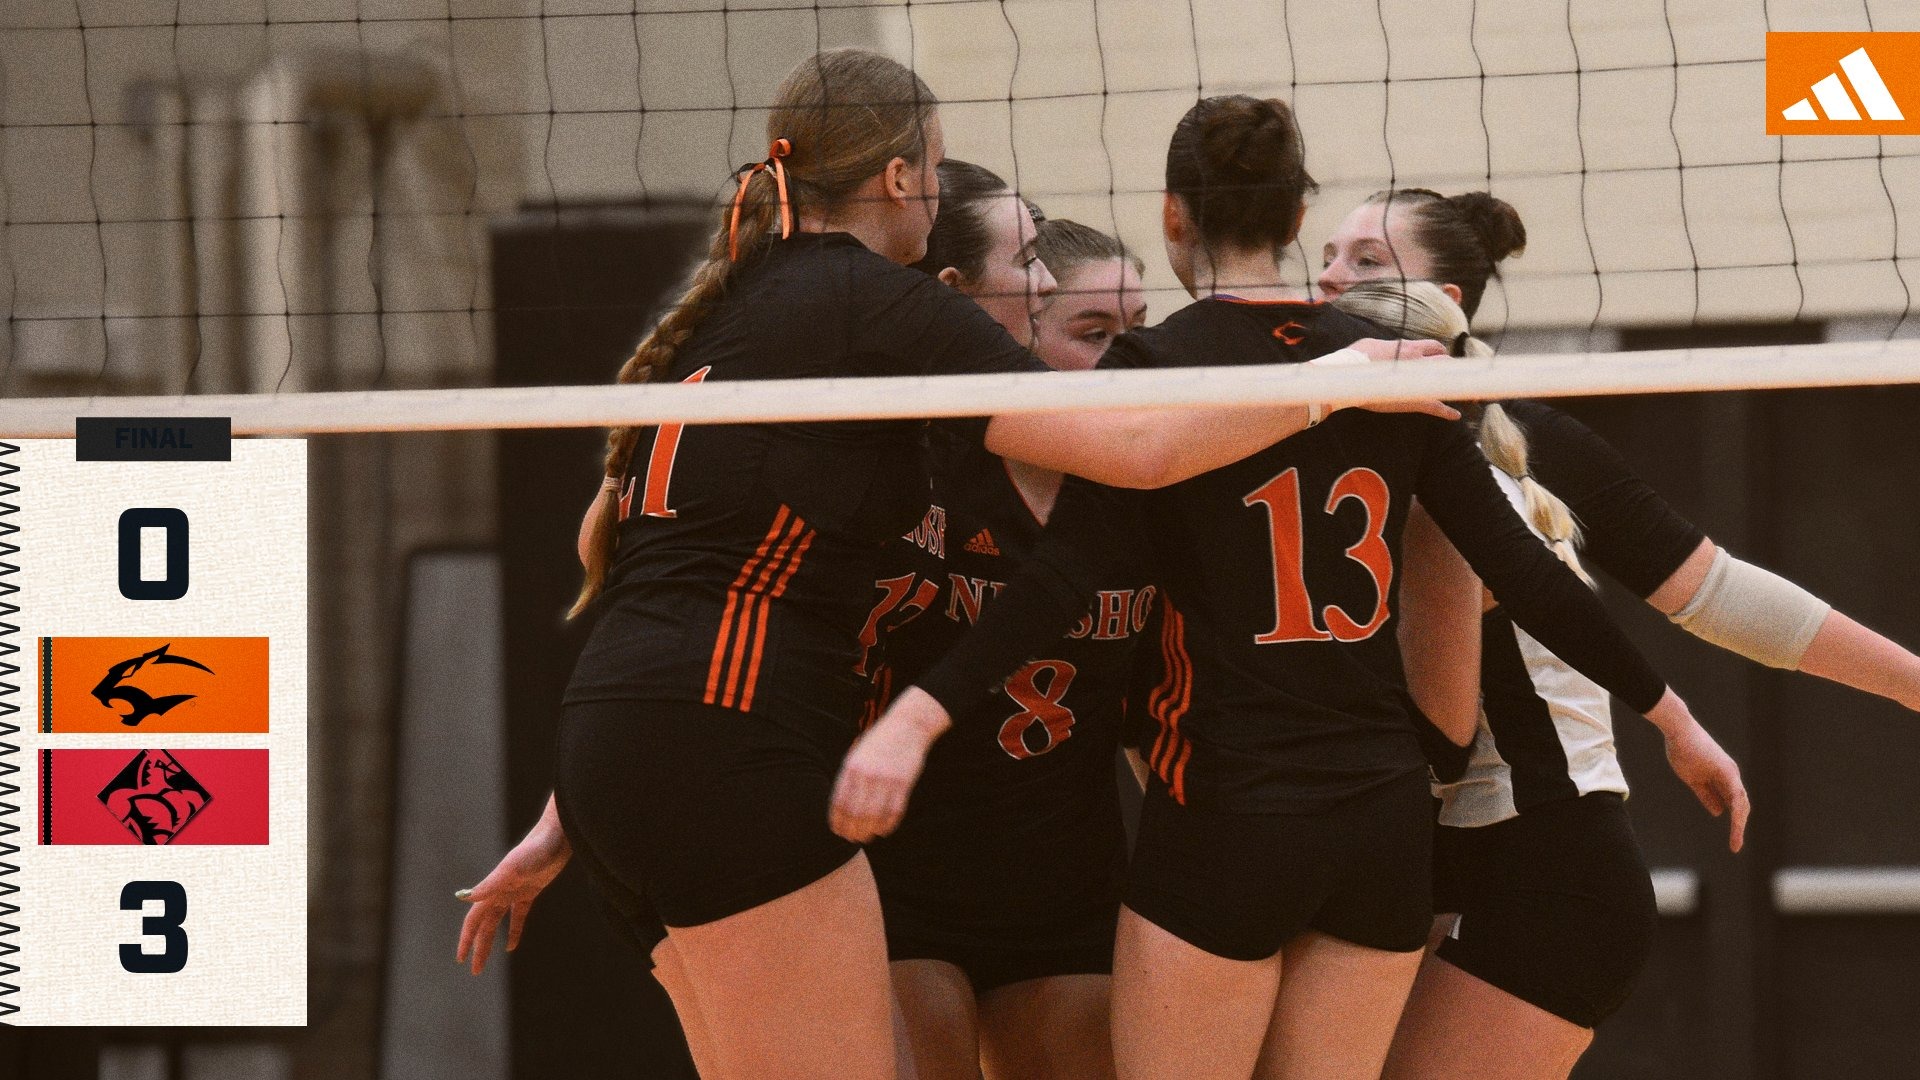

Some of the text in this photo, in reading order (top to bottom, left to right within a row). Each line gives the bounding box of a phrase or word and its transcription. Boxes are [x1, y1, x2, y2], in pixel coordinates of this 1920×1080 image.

[617, 365, 712, 519] 1
[1243, 467, 1393, 644] 13
[997, 659, 1077, 760] 8
